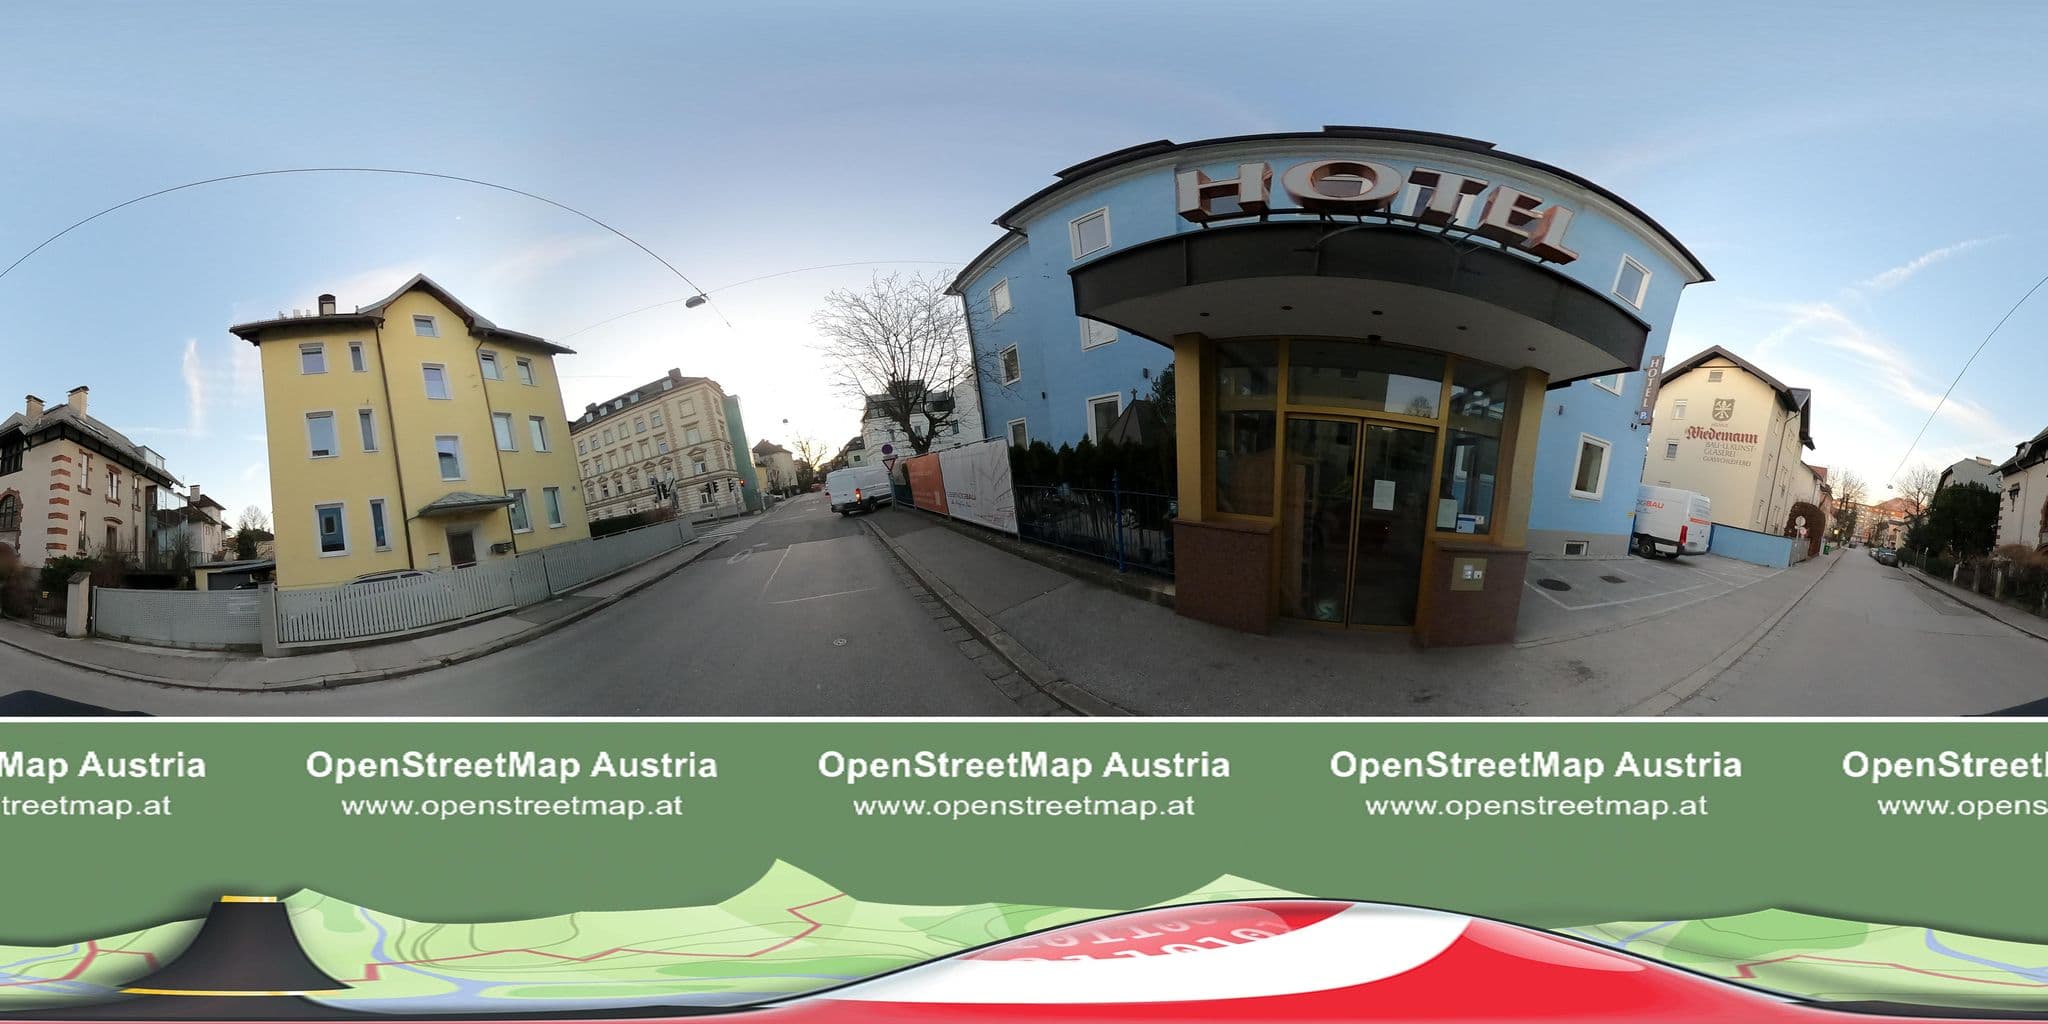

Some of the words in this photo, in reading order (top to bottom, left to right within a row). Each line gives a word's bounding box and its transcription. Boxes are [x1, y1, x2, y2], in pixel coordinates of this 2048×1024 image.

[1177, 159, 1580, 265] HOTEL
[1642, 359, 1660, 408] HOTEL
[1686, 426, 1759, 444] Wiedemann
